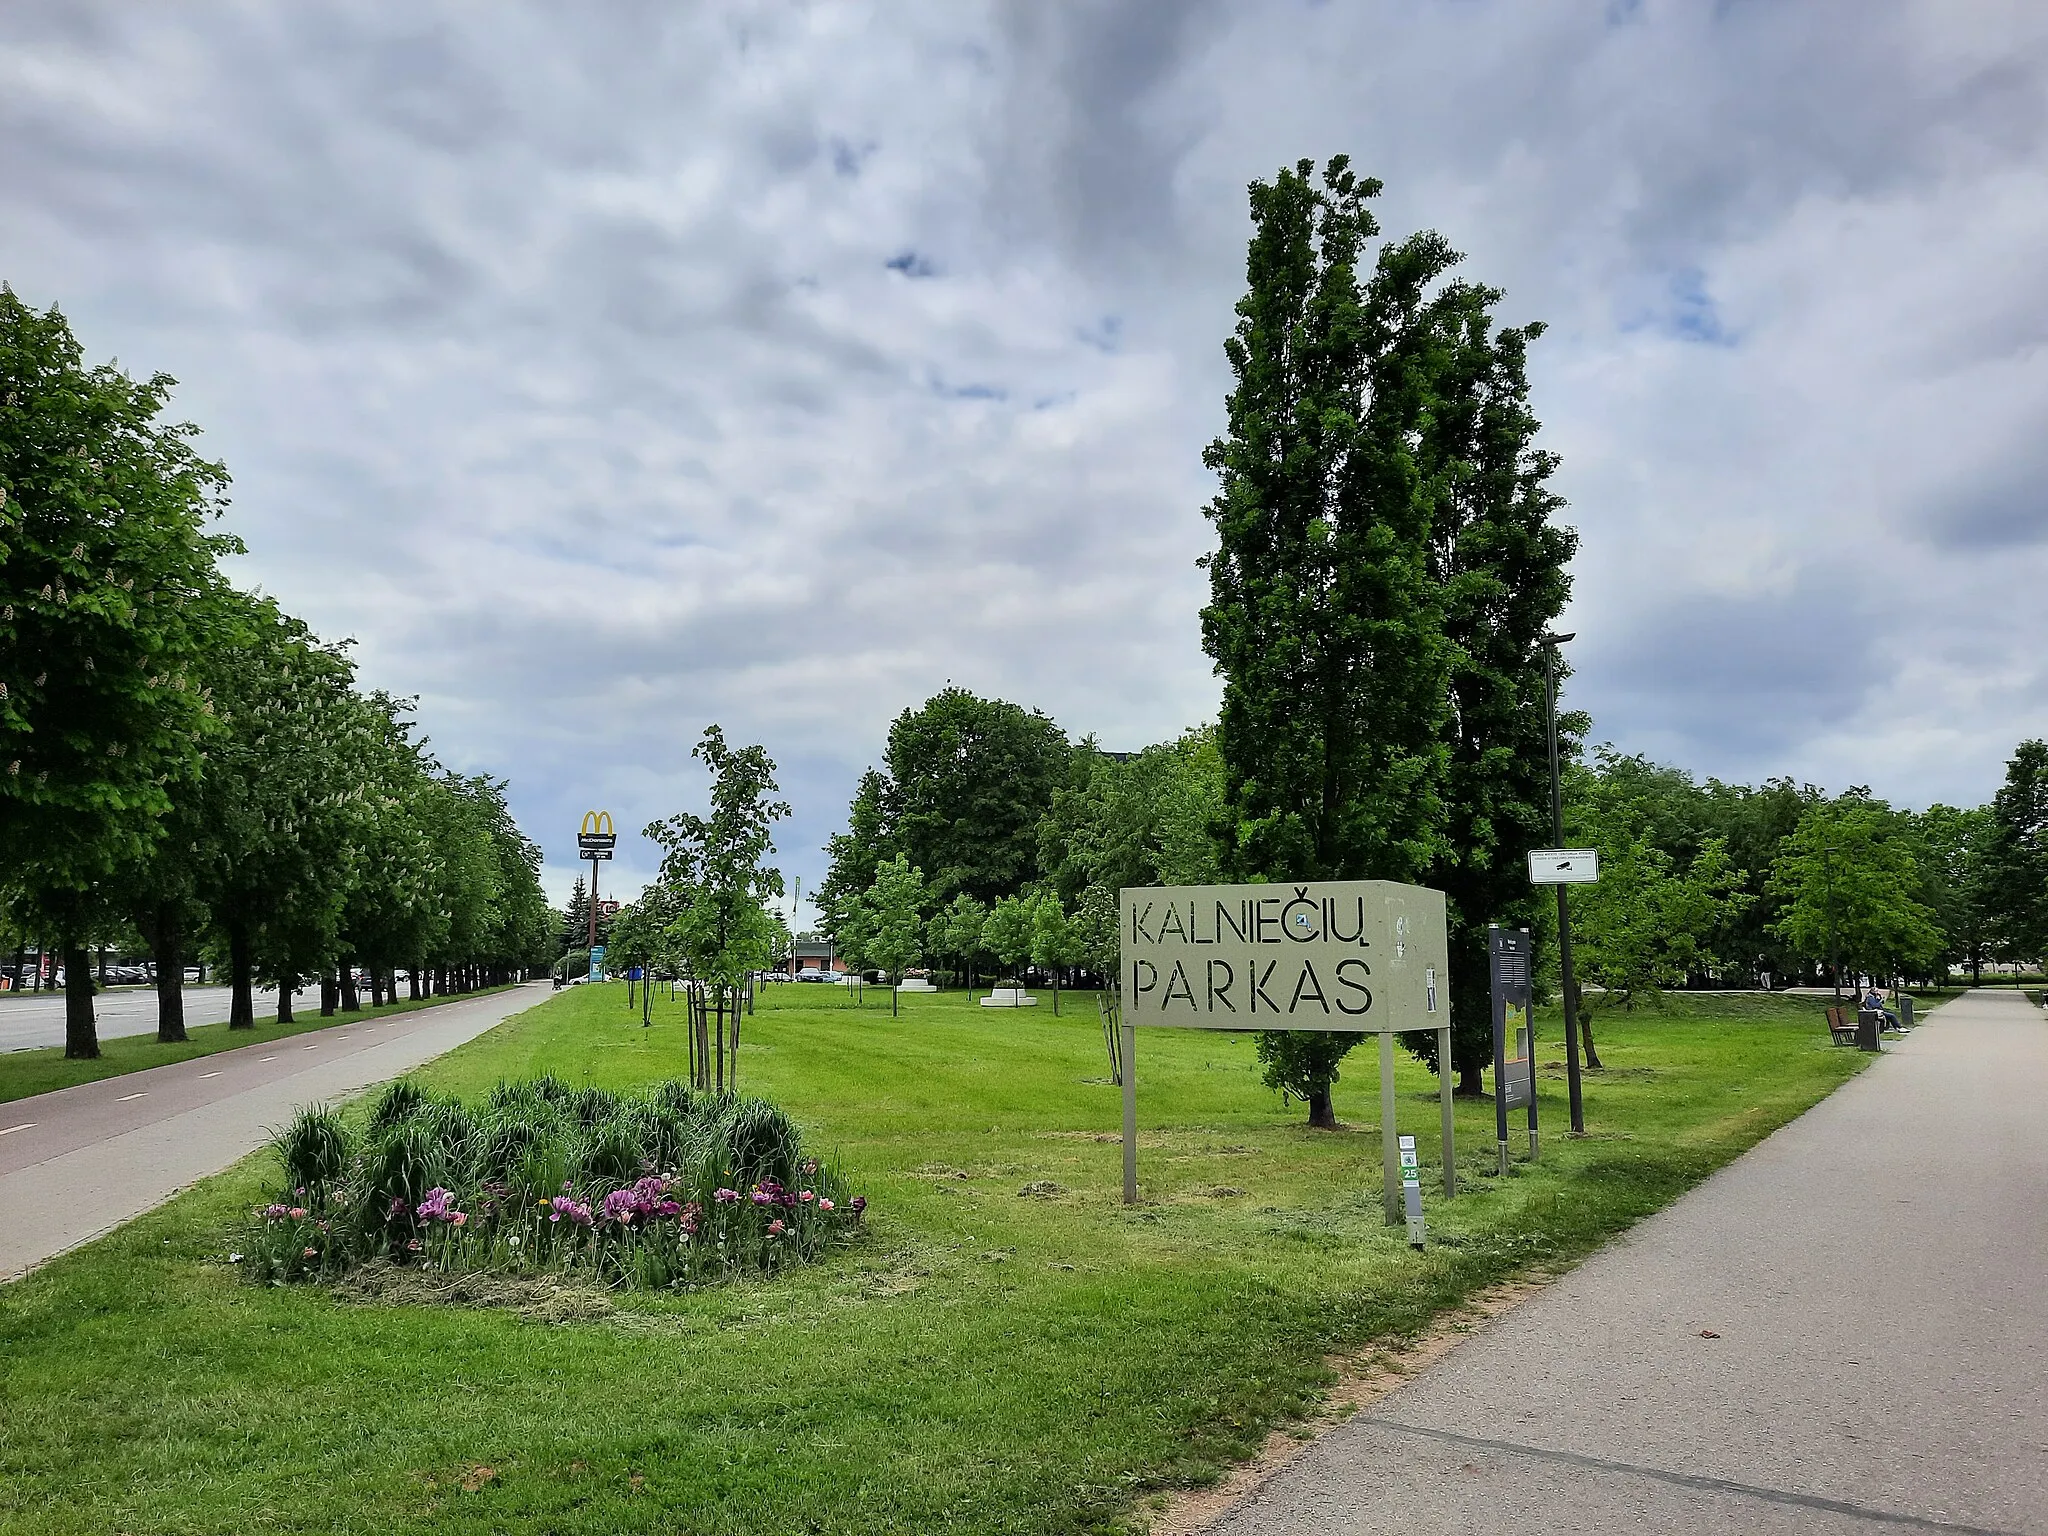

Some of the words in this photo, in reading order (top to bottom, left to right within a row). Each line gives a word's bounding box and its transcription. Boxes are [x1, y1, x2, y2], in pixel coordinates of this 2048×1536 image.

[1132, 886, 1370, 947] KALNIEČIŲ
[1133, 959, 1373, 1015] PARKAS
[1404, 1169, 1417, 1178] 25
